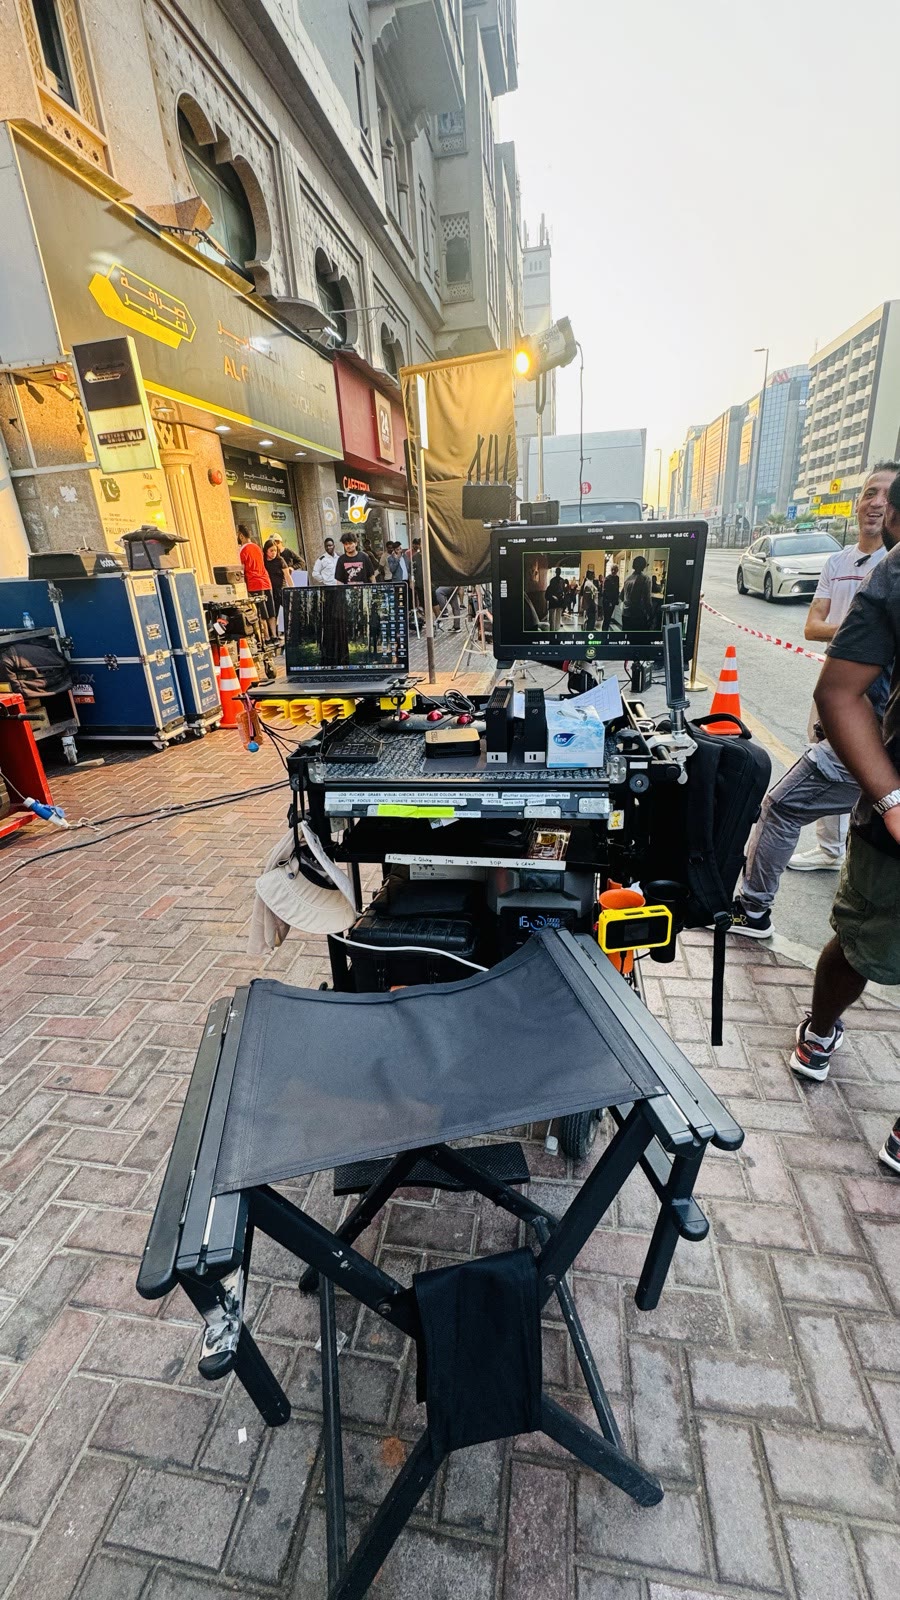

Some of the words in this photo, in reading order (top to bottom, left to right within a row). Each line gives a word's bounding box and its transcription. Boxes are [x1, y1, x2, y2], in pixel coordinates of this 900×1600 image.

[99, 432, 125, 440] WESTERN
[342, 475, 371, 492] CAFETERIA
[555, 734, 567, 743] fine
